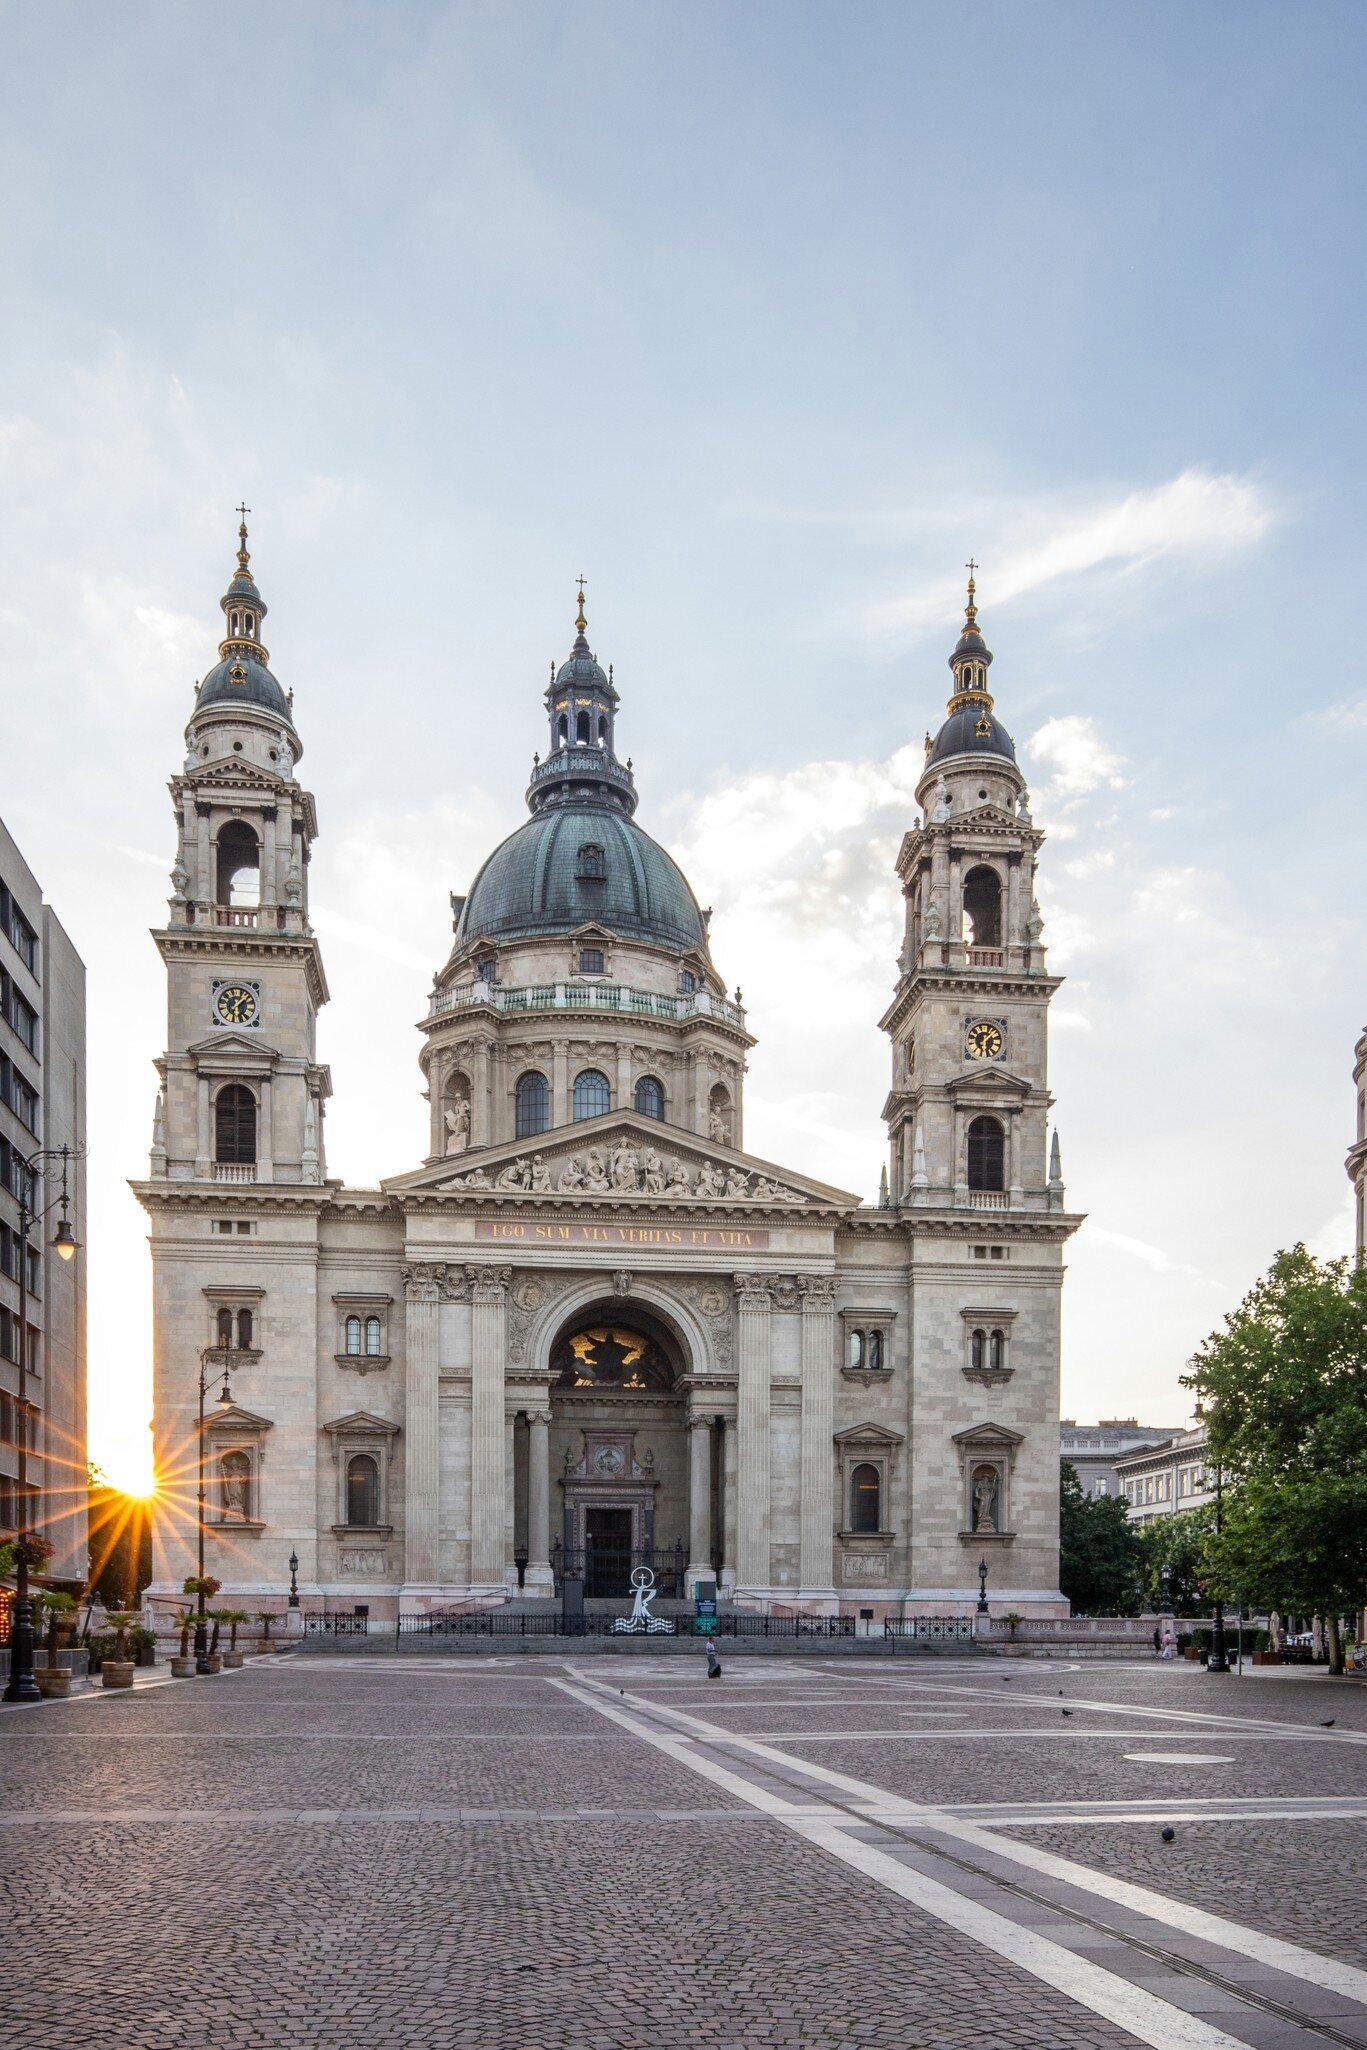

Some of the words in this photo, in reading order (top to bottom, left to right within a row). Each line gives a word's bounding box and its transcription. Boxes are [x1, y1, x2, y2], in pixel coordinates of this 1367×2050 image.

[493, 1224, 525, 1236] EGO
[535, 1226, 570, 1239] SUM
[581, 1228, 609, 1240] VIA
[618, 1228, 682, 1242] VERITAS
[691, 1231, 710, 1244] ET
[719, 1231, 752, 1245] VITA
